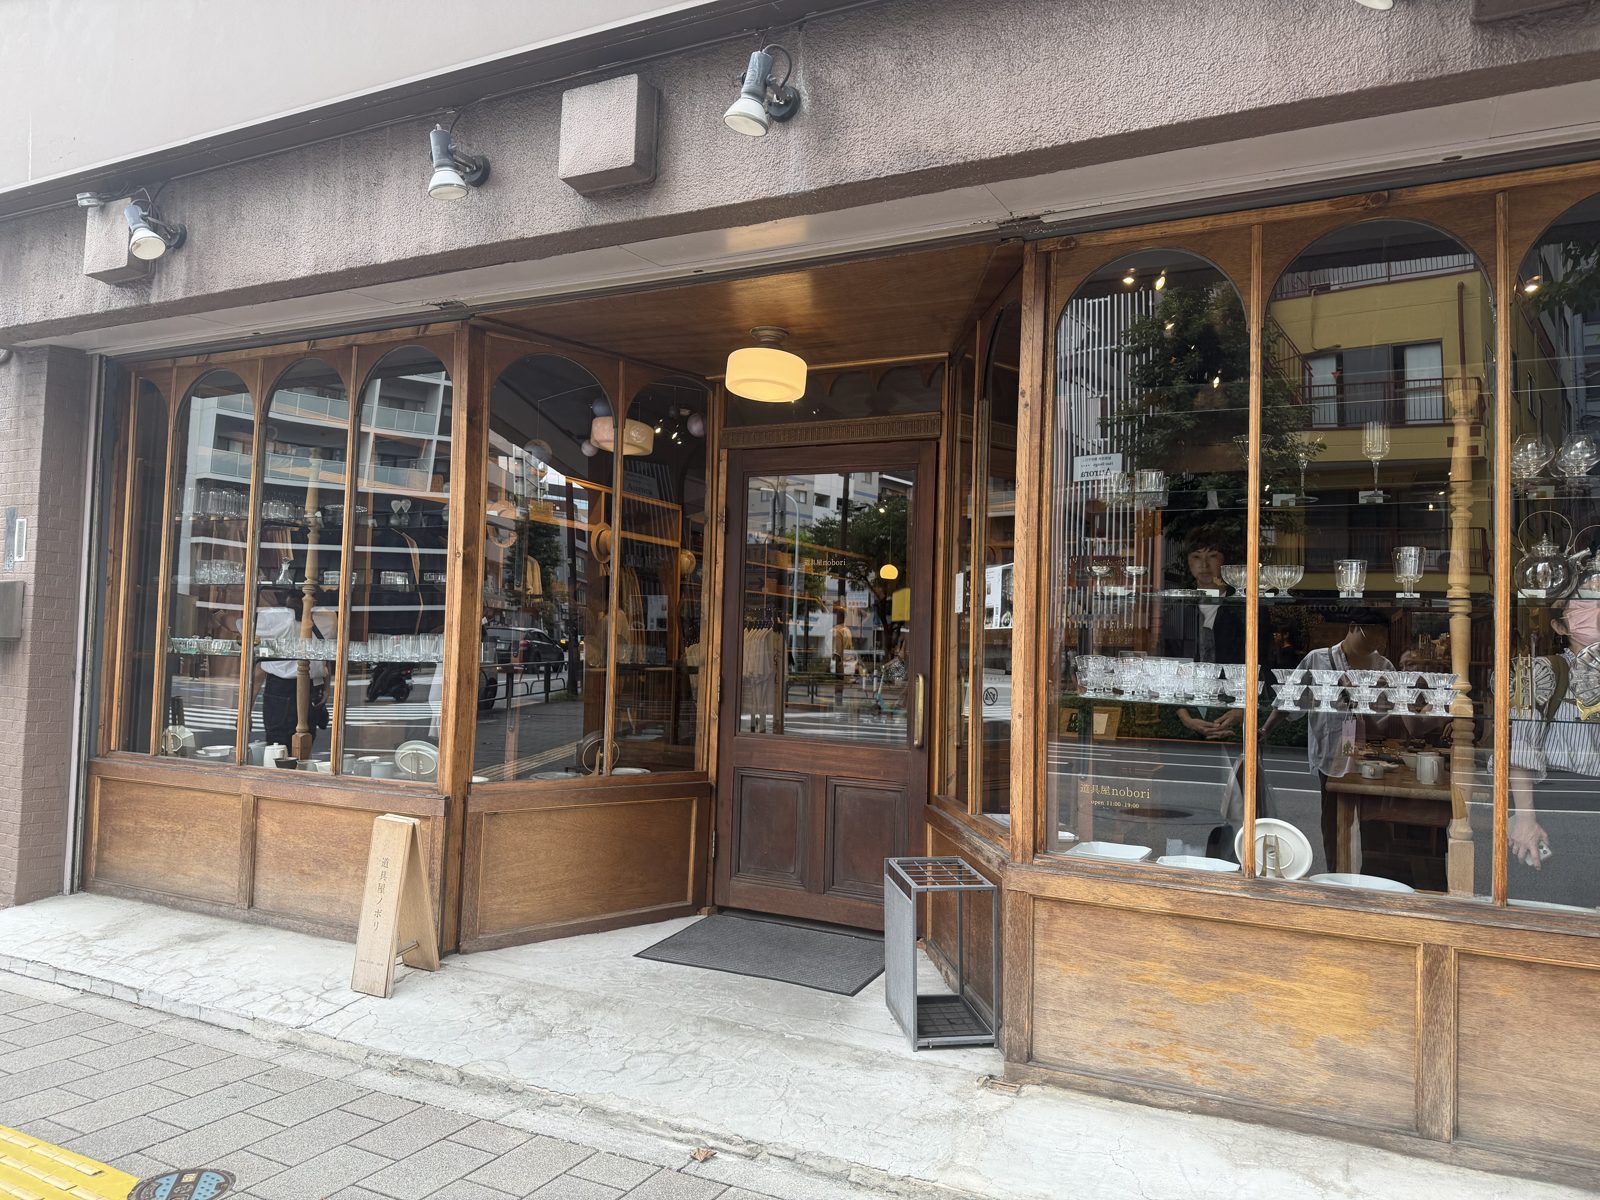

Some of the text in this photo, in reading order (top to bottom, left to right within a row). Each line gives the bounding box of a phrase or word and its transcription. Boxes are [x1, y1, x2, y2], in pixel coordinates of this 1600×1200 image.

[373, 857, 390, 932] 道具屋ノボリ
